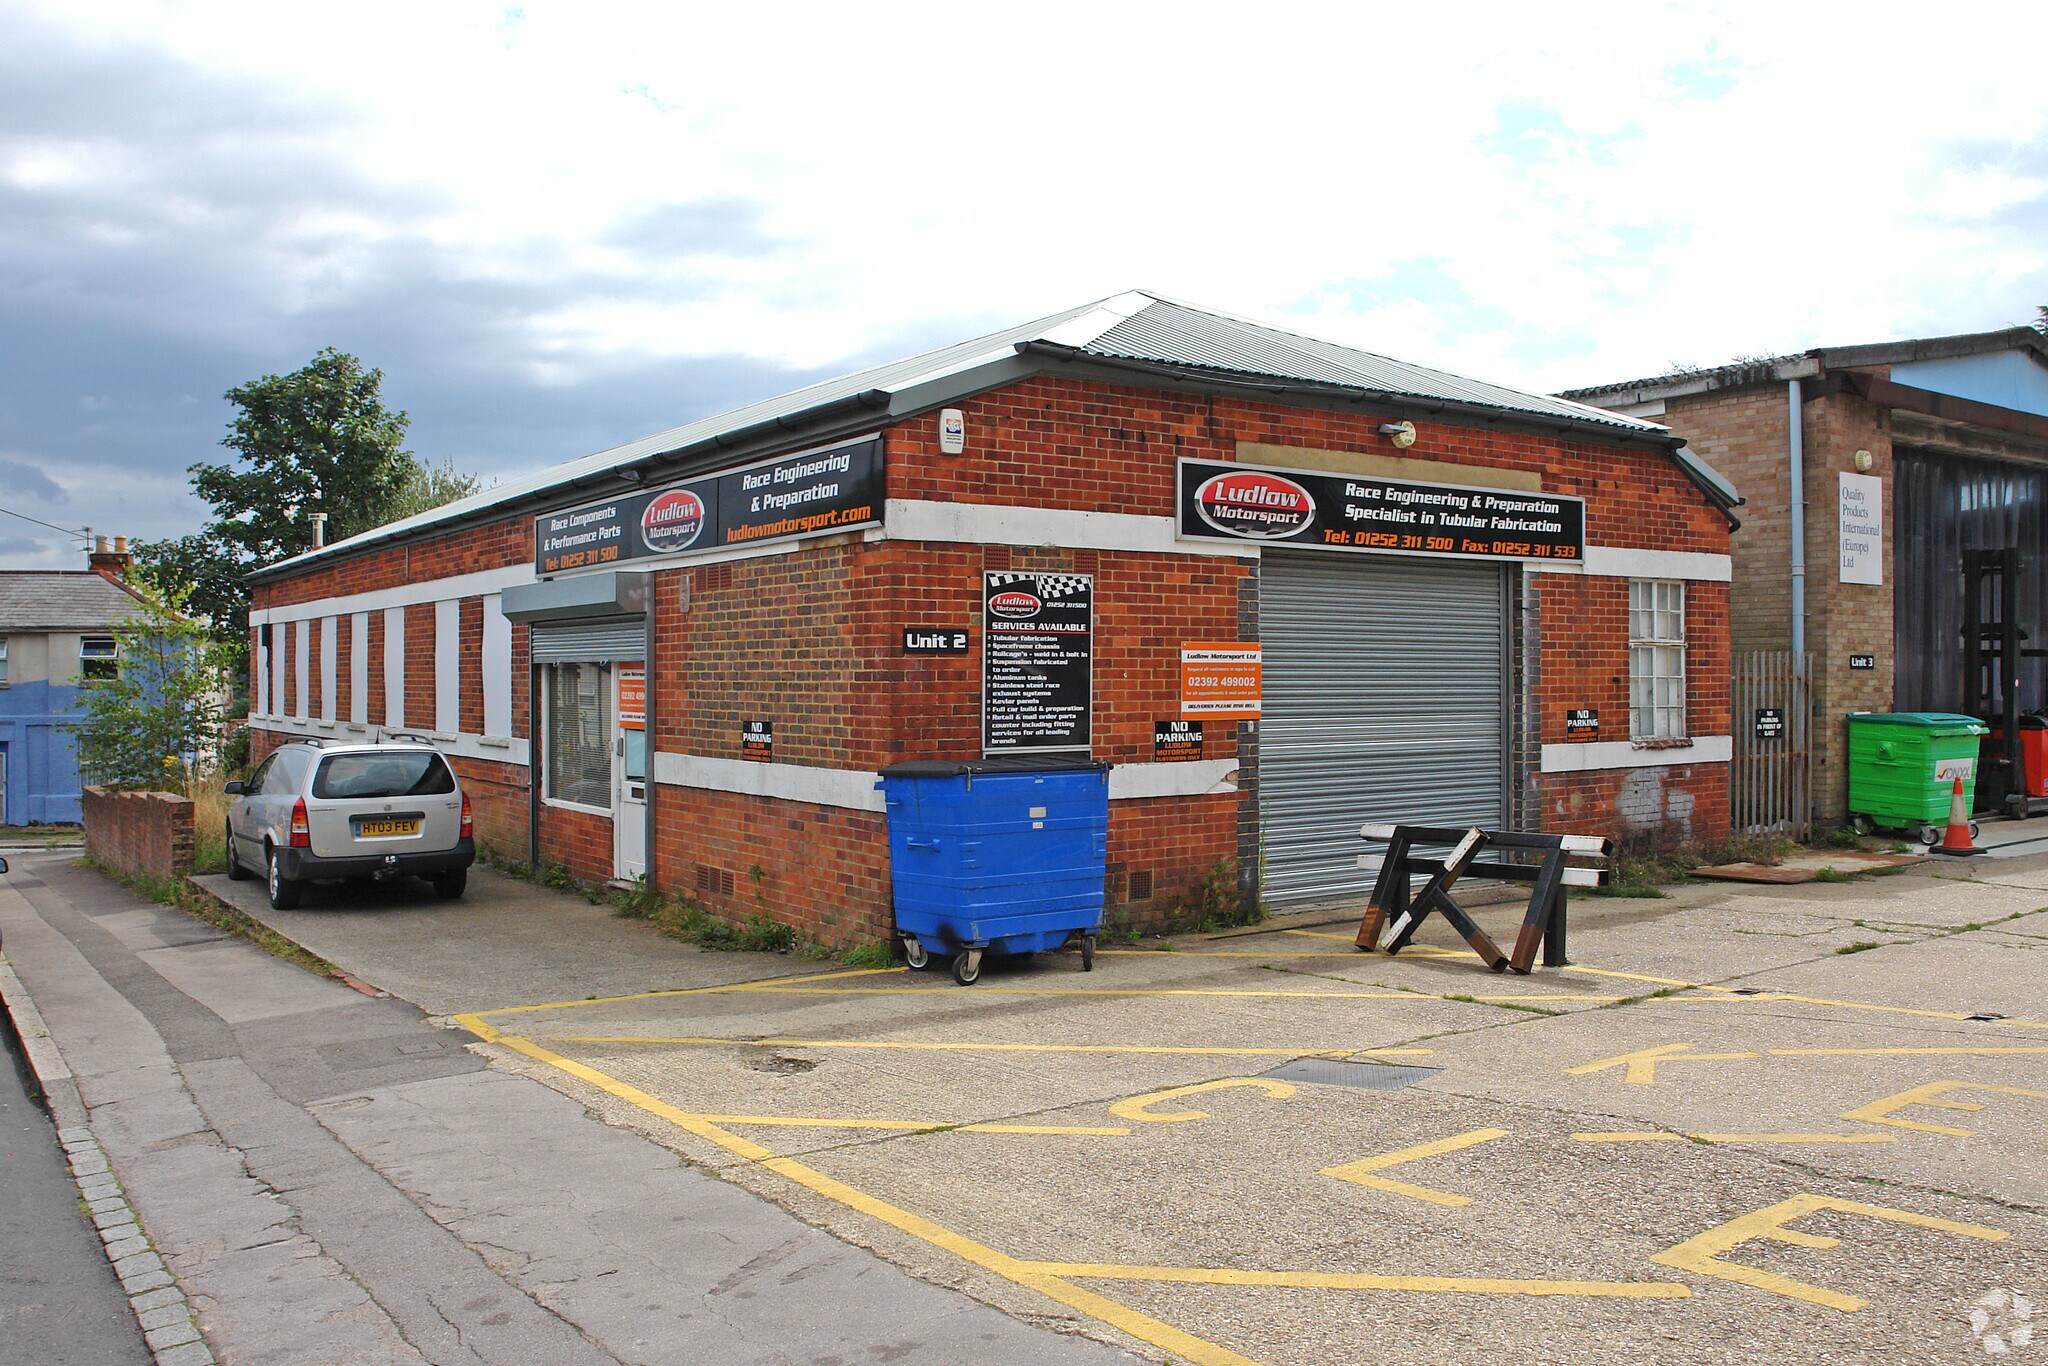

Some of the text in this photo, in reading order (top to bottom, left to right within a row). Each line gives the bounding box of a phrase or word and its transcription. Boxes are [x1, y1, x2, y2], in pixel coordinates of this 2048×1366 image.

[742, 454, 851, 491] Race Engineering
[751, 483, 839, 513] & Preparation
[1214, 481, 1301, 507] Ludlow
[1345, 482, 1560, 513] Race Engineering & Preparation
[1842, 486, 1865, 505] Quality
[650, 501, 697, 524] Ludlow
[1213, 504, 1300, 524] Motorsport
[1842, 503, 1869, 518] Products
[551, 506, 616, 532] Race Components
[726, 505, 871, 542] ludlowmotorsport.com
[1344, 503, 1562, 533] Specialist in Tubular Fabrication
[649, 521, 695, 539] Motorsport
[1842, 520, 1880, 536] International
[544, 525, 621, 551] & Performance Parts
[1323, 529, 1576, 558] Tel: 01252 311 500 Fax: 01252 311 533
[1842, 538, 1869, 556] (Europe)
[545, 545, 618, 571] Tel: 01252 311 500
[1843, 555, 1854, 568] Ltd
[996, 596, 1035, 606] Ludlow
[996, 605, 1034, 613] Motorsport
[991, 622, 1087, 632] SERVICES AVAILABLE
[906, 633, 966, 648] Unit 2
[1851, 657, 1873, 666] Unit 3
[1188, 676, 1256, 687] 02392 499002
[1016, 698, 1040, 706] panels
[1045, 705, 1084, 713] preparation
[1058, 713, 1077, 721] parts
[1577, 710, 1589, 718] NO
[751, 722, 763, 732] NO
[1021, 721, 1052, 729] including
[1171, 721, 1188, 732] NO
[1567, 718, 1598, 727] PARKING
[743, 732, 772, 743] PARKING
[1156, 732, 1202, 742] PARKING
[1156, 748, 1201, 756] MOTORSPORT
[1946, 766, 1970, 780] ONYX
[363, 820, 416, 834] HT03 FEV
